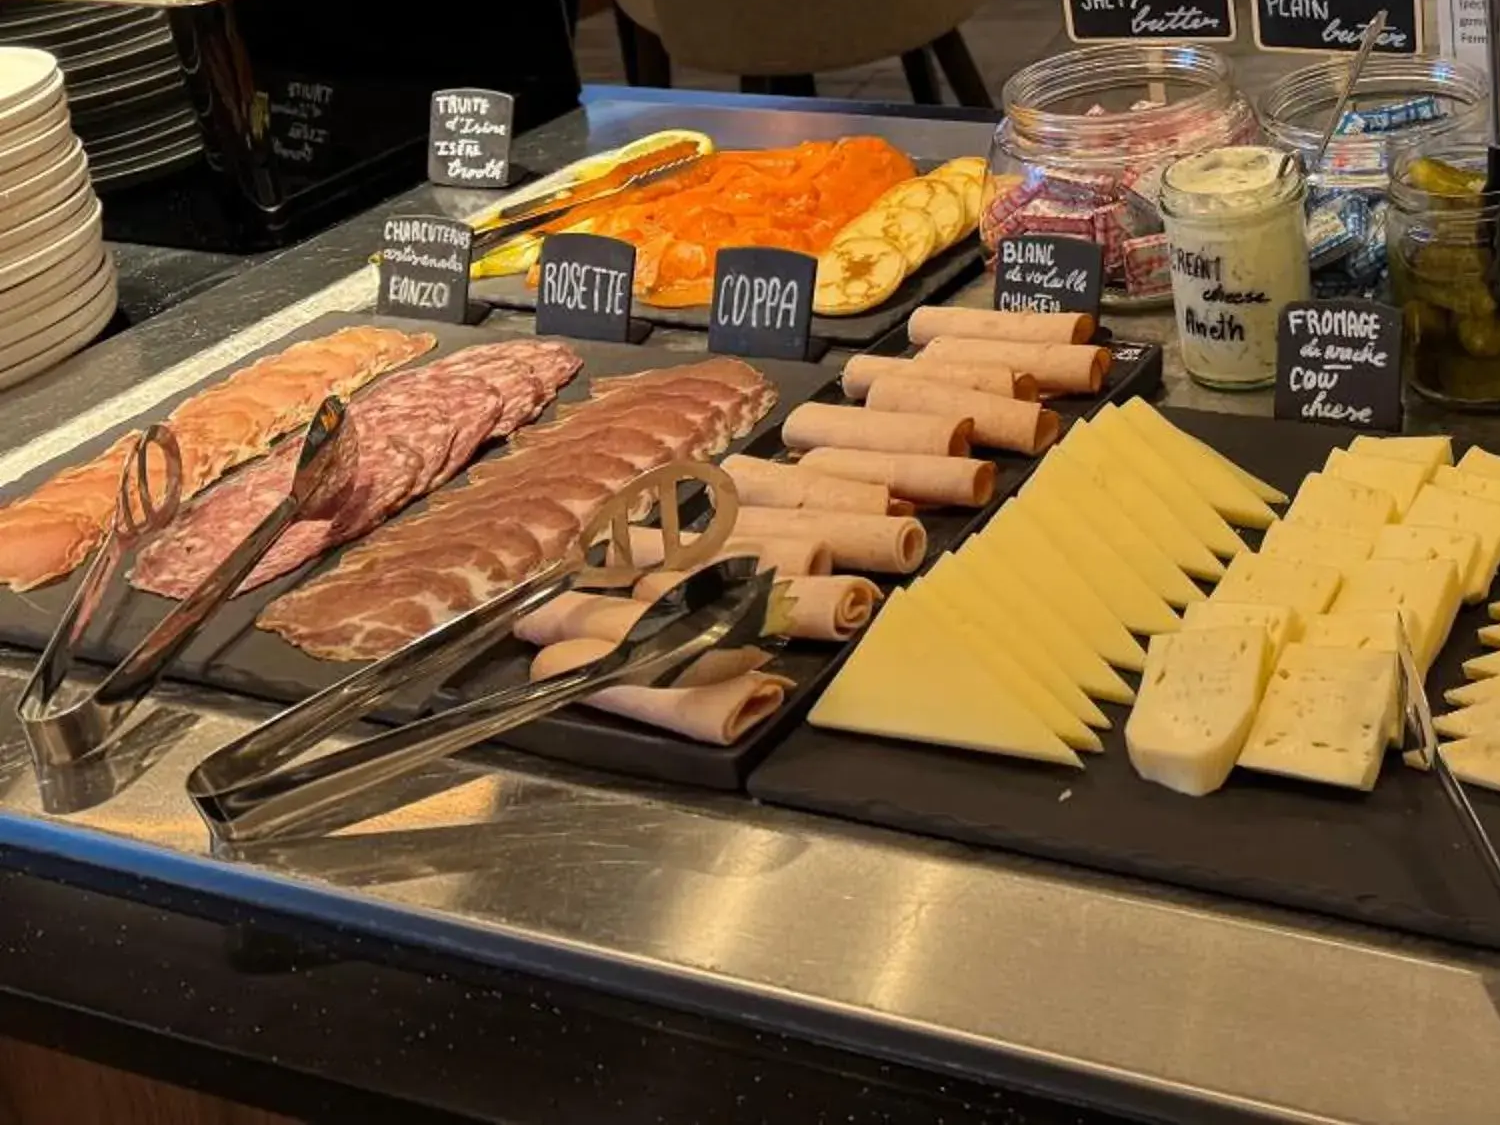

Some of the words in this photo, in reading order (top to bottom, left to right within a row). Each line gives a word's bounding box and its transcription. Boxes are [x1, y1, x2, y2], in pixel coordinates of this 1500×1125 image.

[1322, 18, 1407, 47] buer
[1002, 241, 1055, 266] BLANC
[544, 262, 628, 315] ROSETTE
[718, 274, 798, 329] COPPA
[1288, 309, 1380, 340] FROMAGE
